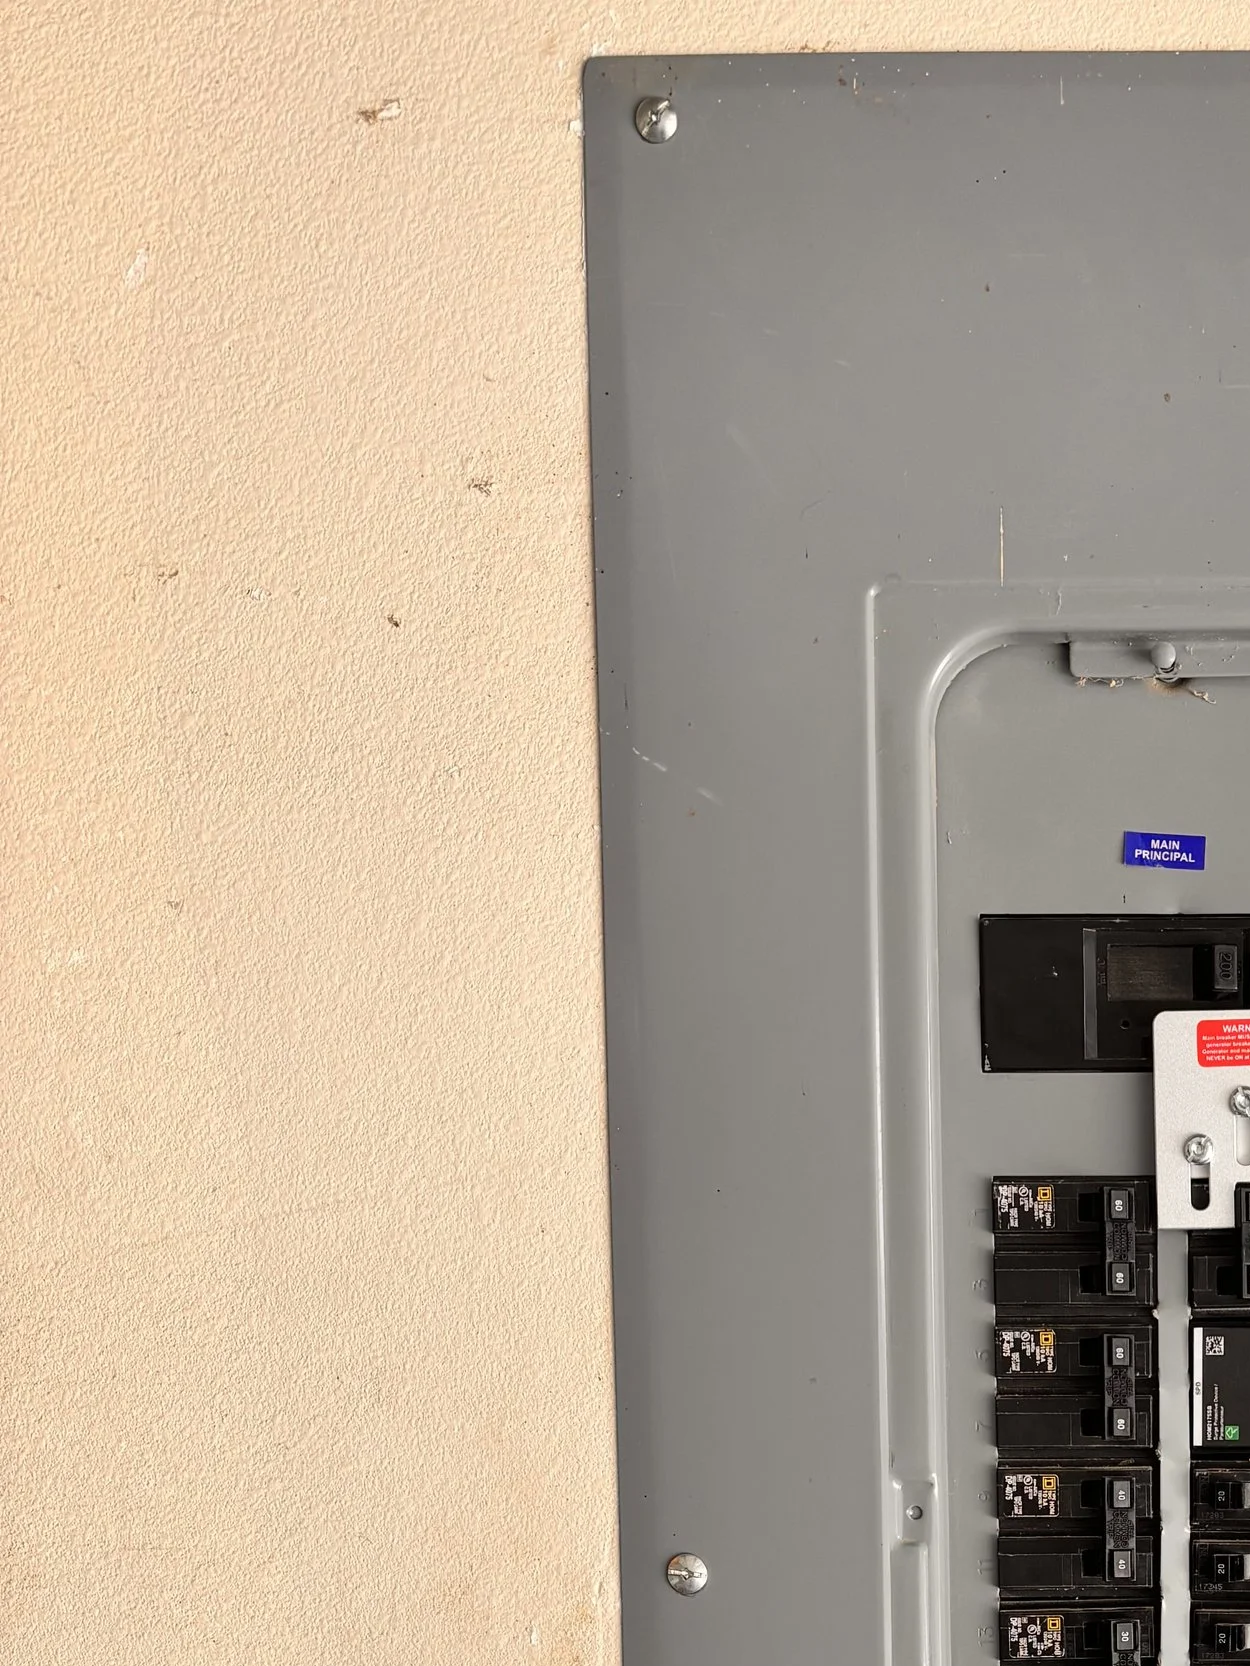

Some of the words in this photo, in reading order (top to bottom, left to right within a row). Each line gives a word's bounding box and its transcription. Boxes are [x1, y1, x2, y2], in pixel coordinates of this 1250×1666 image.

[1151, 838, 1180, 850] MAIN
[1134, 848, 1196, 862] PRINCIPAL
[1218, 952, 1233, 980] 200
[1115, 1200, 1124, 1211] 60
[1116, 1272, 1124, 1284] 60
[1116, 1347, 1124, 1359] 60
[1117, 1418, 1125, 1430] 60
[1119, 1560, 1125, 1570] 40
[1218, 1563, 1225, 1574] 20
[1122, 1631, 1128, 1642] 30
[1219, 1633, 1225, 1644] 20
